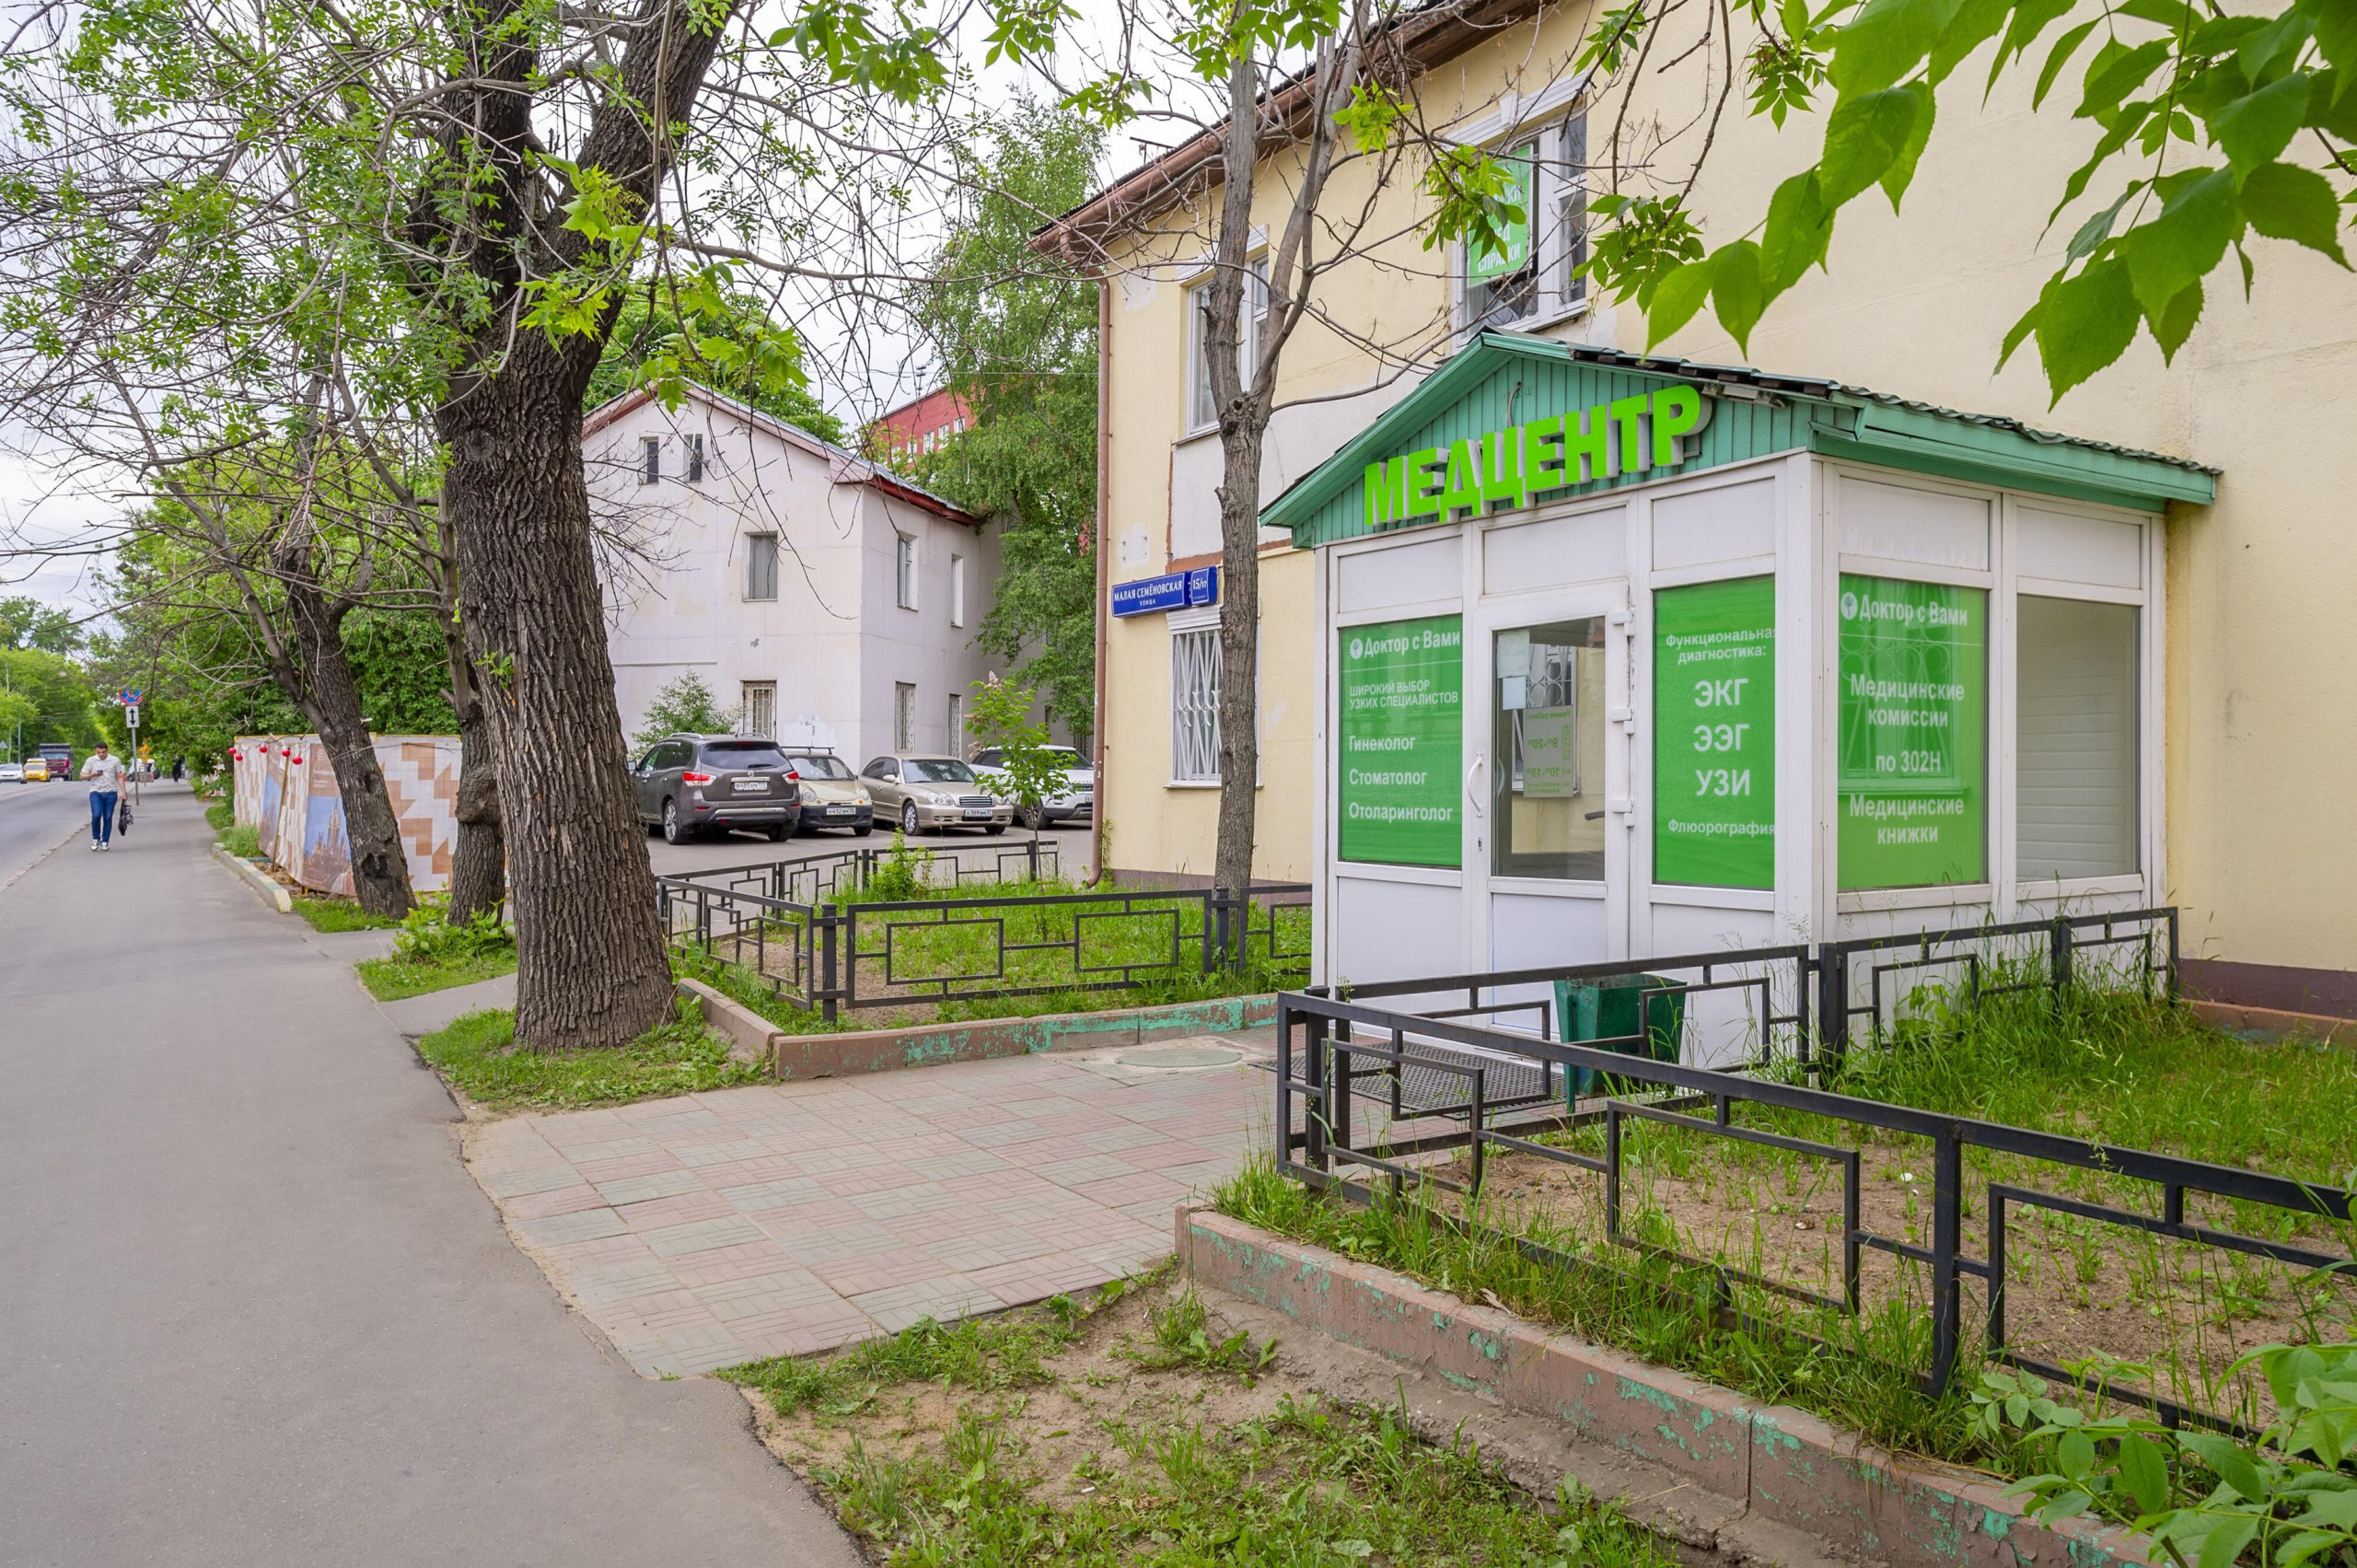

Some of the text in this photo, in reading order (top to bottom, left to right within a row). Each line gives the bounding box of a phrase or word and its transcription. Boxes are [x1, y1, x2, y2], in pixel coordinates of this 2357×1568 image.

[1478, 243, 1521, 273] СПРАКИ
[1364, 384, 1710, 526] МЕДЦЕНТР
[1114, 589, 1135, 601] МАЛАЯ
[1137, 580, 1182, 598] СЕМЁНОВСКАЯ
[1192, 578, 1207, 590] 15/17
[1859, 594, 1968, 626] Доктор с Вами
[1364, 630, 1460, 658] Доктор с Вами
[1678, 645, 1766, 665] диагностика:
[1350, 679, 1430, 697] ШИРОКИЙ ВЫБОР
[1694, 679, 1748, 707] ЭКГ
[1850, 673, 1965, 702] Медицинские
[1350, 691, 1458, 710] УЗКИХ СПЕЦИАЛИСТОВ
[1868, 708, 1948, 727] комиссии
[1349, 736, 1415, 752] Гинеколог
[1693, 723, 1749, 752] ЭЭГ
[1875, 749, 1941, 772] по 302Н
[1349, 768, 1427, 785] Стоматолог
[1695, 769, 1750, 796] УЗИ
[1349, 802, 1453, 823] Отоларинголог
[1849, 794, 1964, 821] Медицинские
[1668, 819, 1775, 838] Флюорография
[1877, 825, 1938, 844] книжки
